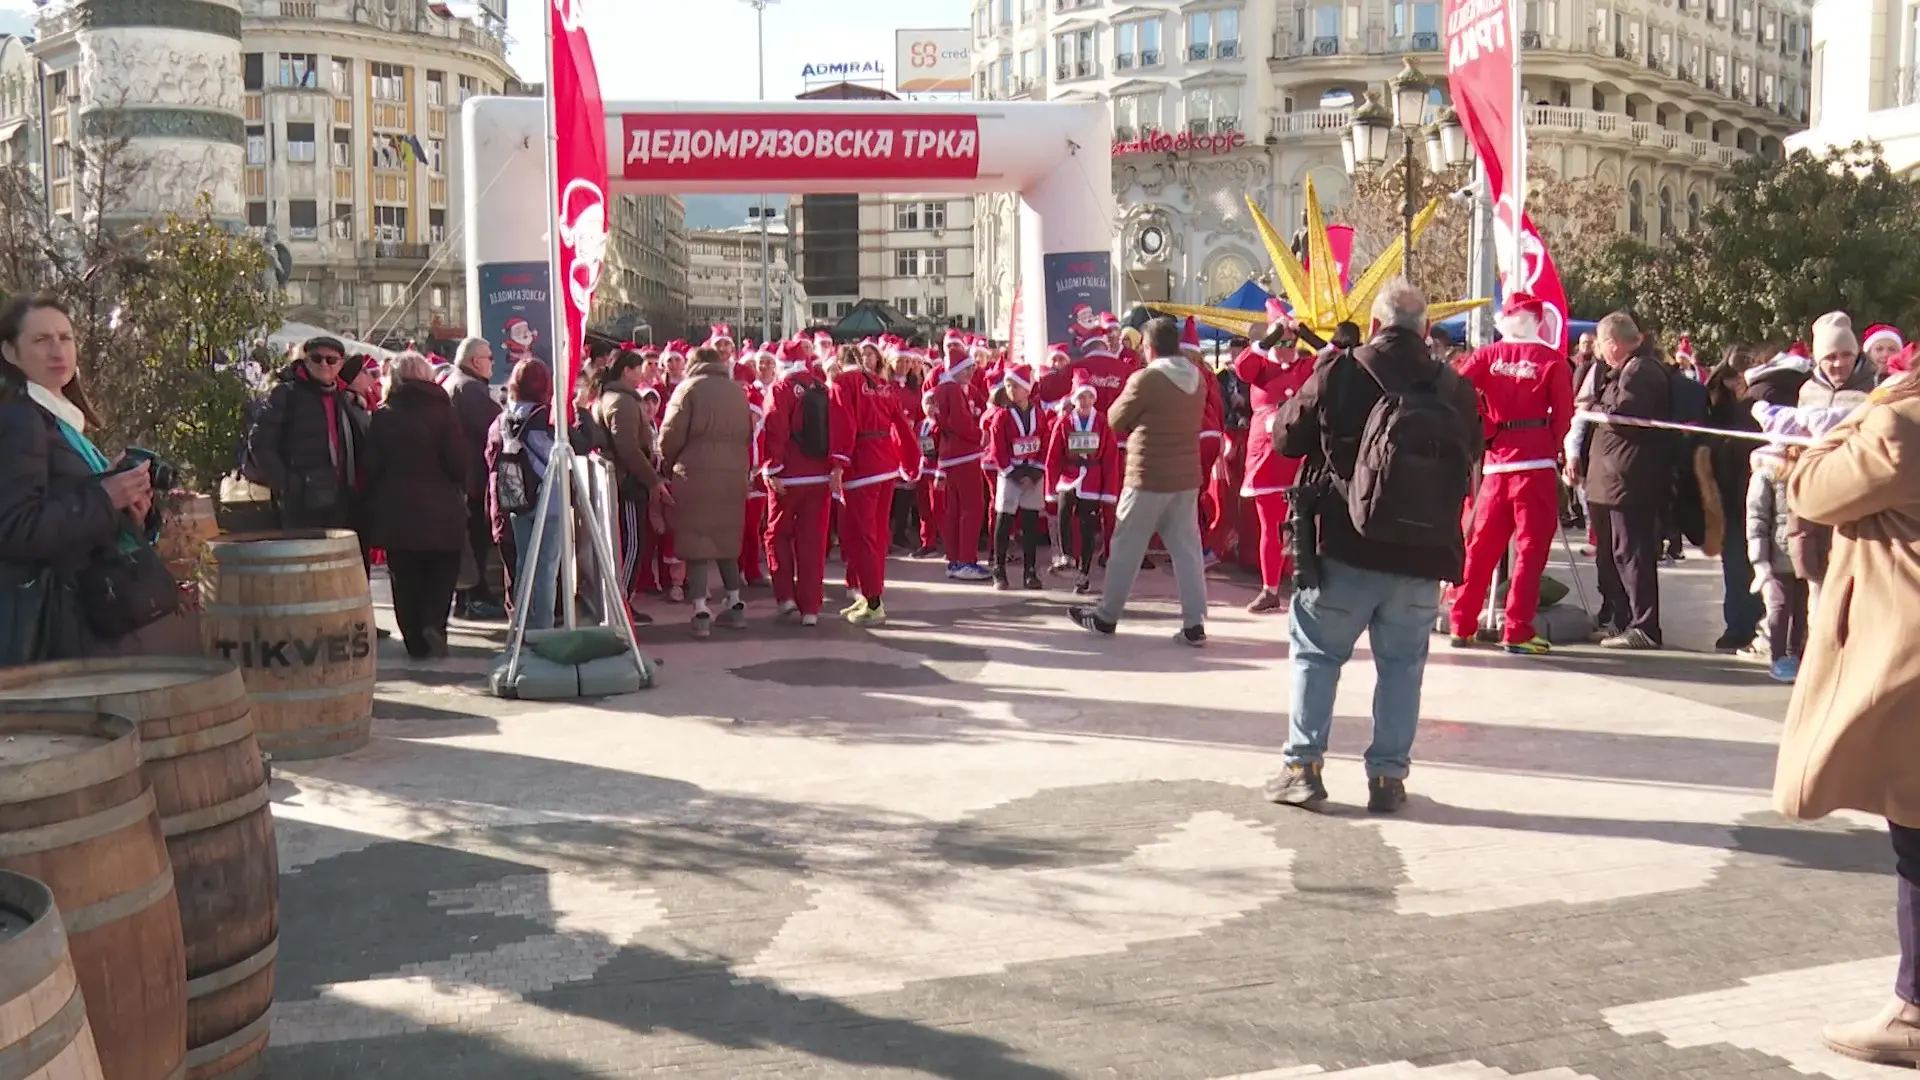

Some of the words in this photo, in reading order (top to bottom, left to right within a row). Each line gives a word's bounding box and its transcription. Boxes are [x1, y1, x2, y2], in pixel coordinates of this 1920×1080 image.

[801, 59, 884, 77] ADMIRAL
[626, 128, 893, 164] ДЕДОМРАЗОВСКА
[902, 128, 977, 159] ТРКА
[214, 620, 370, 669] TIKVEŠ
